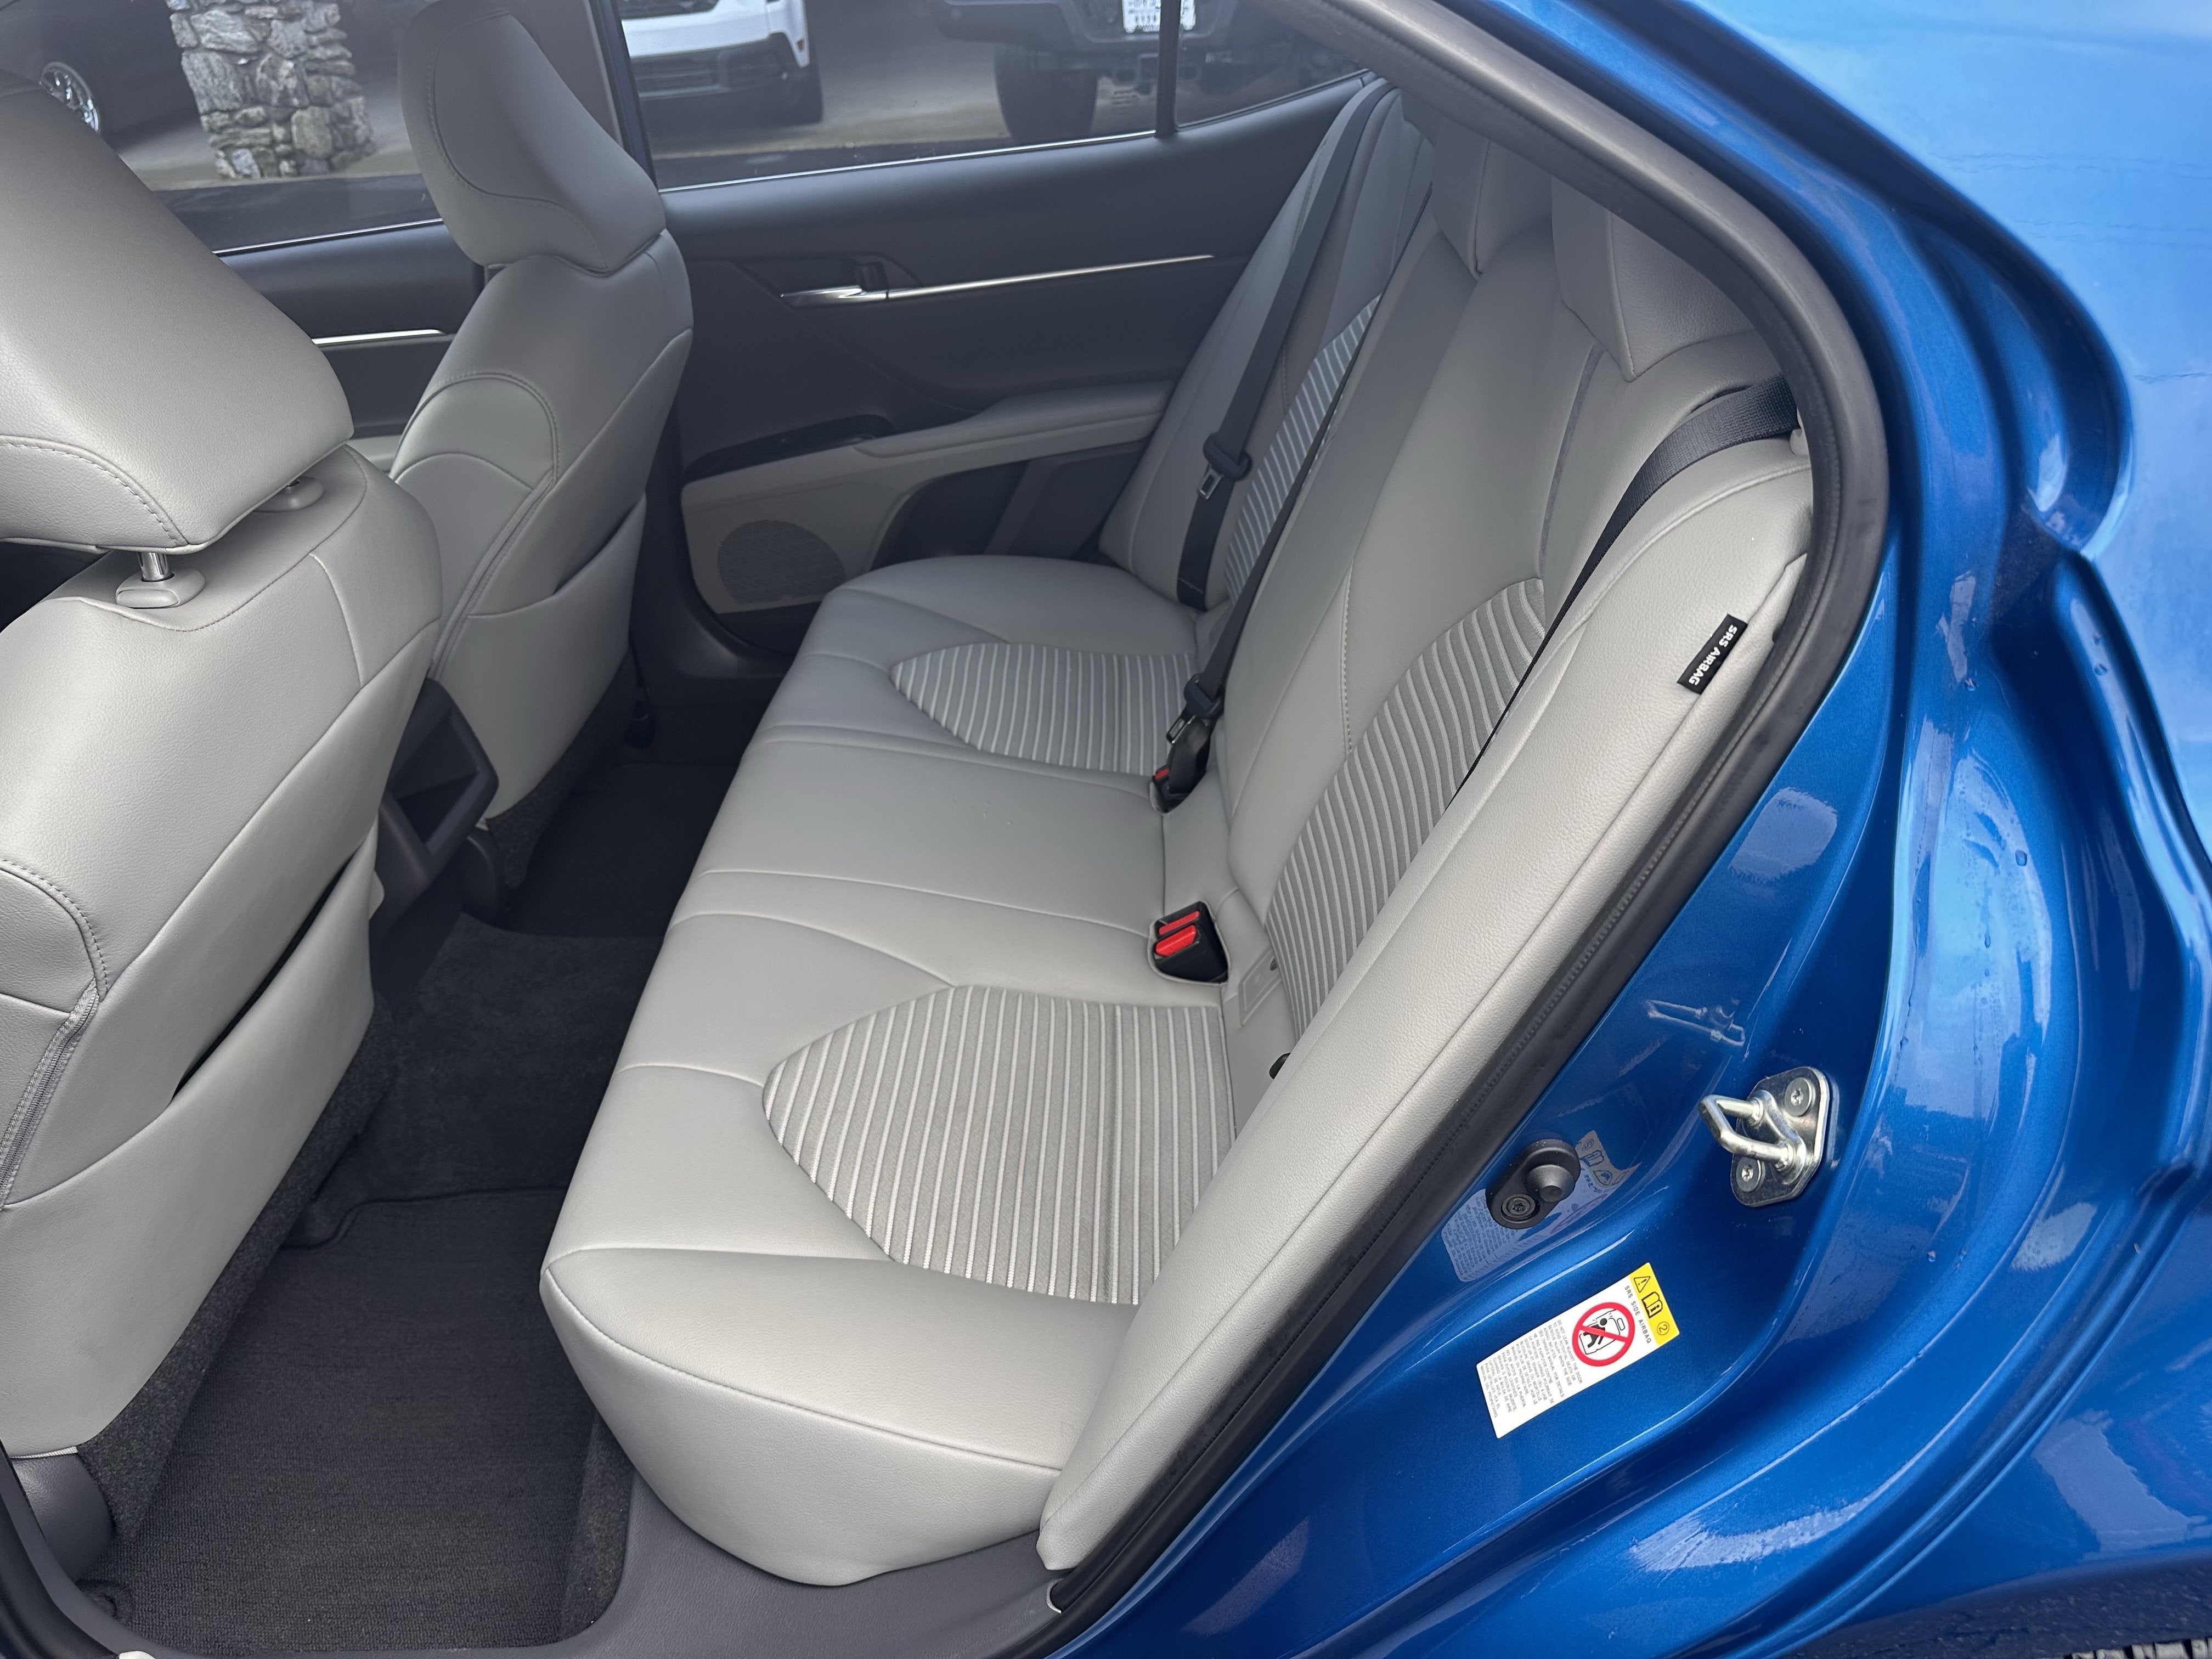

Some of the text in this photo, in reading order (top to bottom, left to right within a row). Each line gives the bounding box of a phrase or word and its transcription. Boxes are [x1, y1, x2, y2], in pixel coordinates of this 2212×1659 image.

[1689, 624, 1737, 686] SRS AIRBAG
[1624, 1285, 1651, 1344] SRS SIDE AIRBAG
